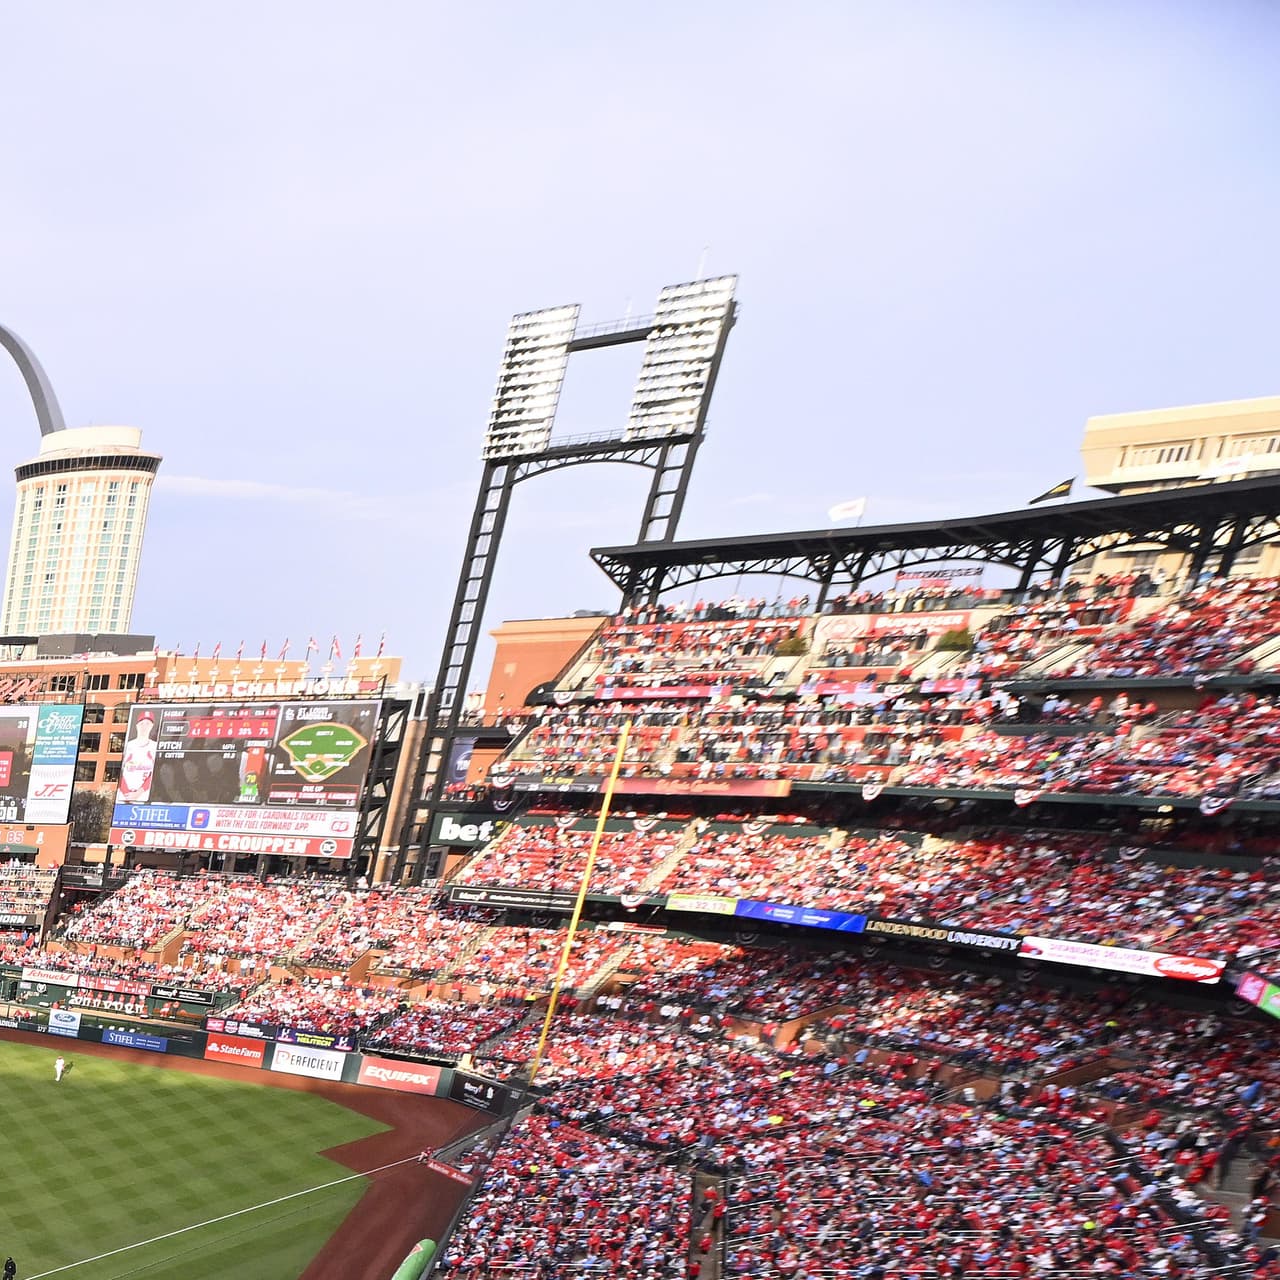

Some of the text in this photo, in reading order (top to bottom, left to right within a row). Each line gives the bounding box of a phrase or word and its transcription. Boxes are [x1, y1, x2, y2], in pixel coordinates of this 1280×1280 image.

[158, 679, 360, 699] WORLD CHAMPIONS
[159, 742, 182, 751] PITCH
[129, 806, 171, 822] STIFEL
[6, 830, 24, 843] 85
[144, 831, 200, 848] BROWN
[218, 836, 310, 853] CROUPPEN
[866, 920, 1021, 950] LINDENWOOD UNIVERSITY
[27, 970, 76, 982] Schnucks
[109, 1032, 135, 1045] STIFEL
[364, 1065, 433, 1086] EQUIFAX
